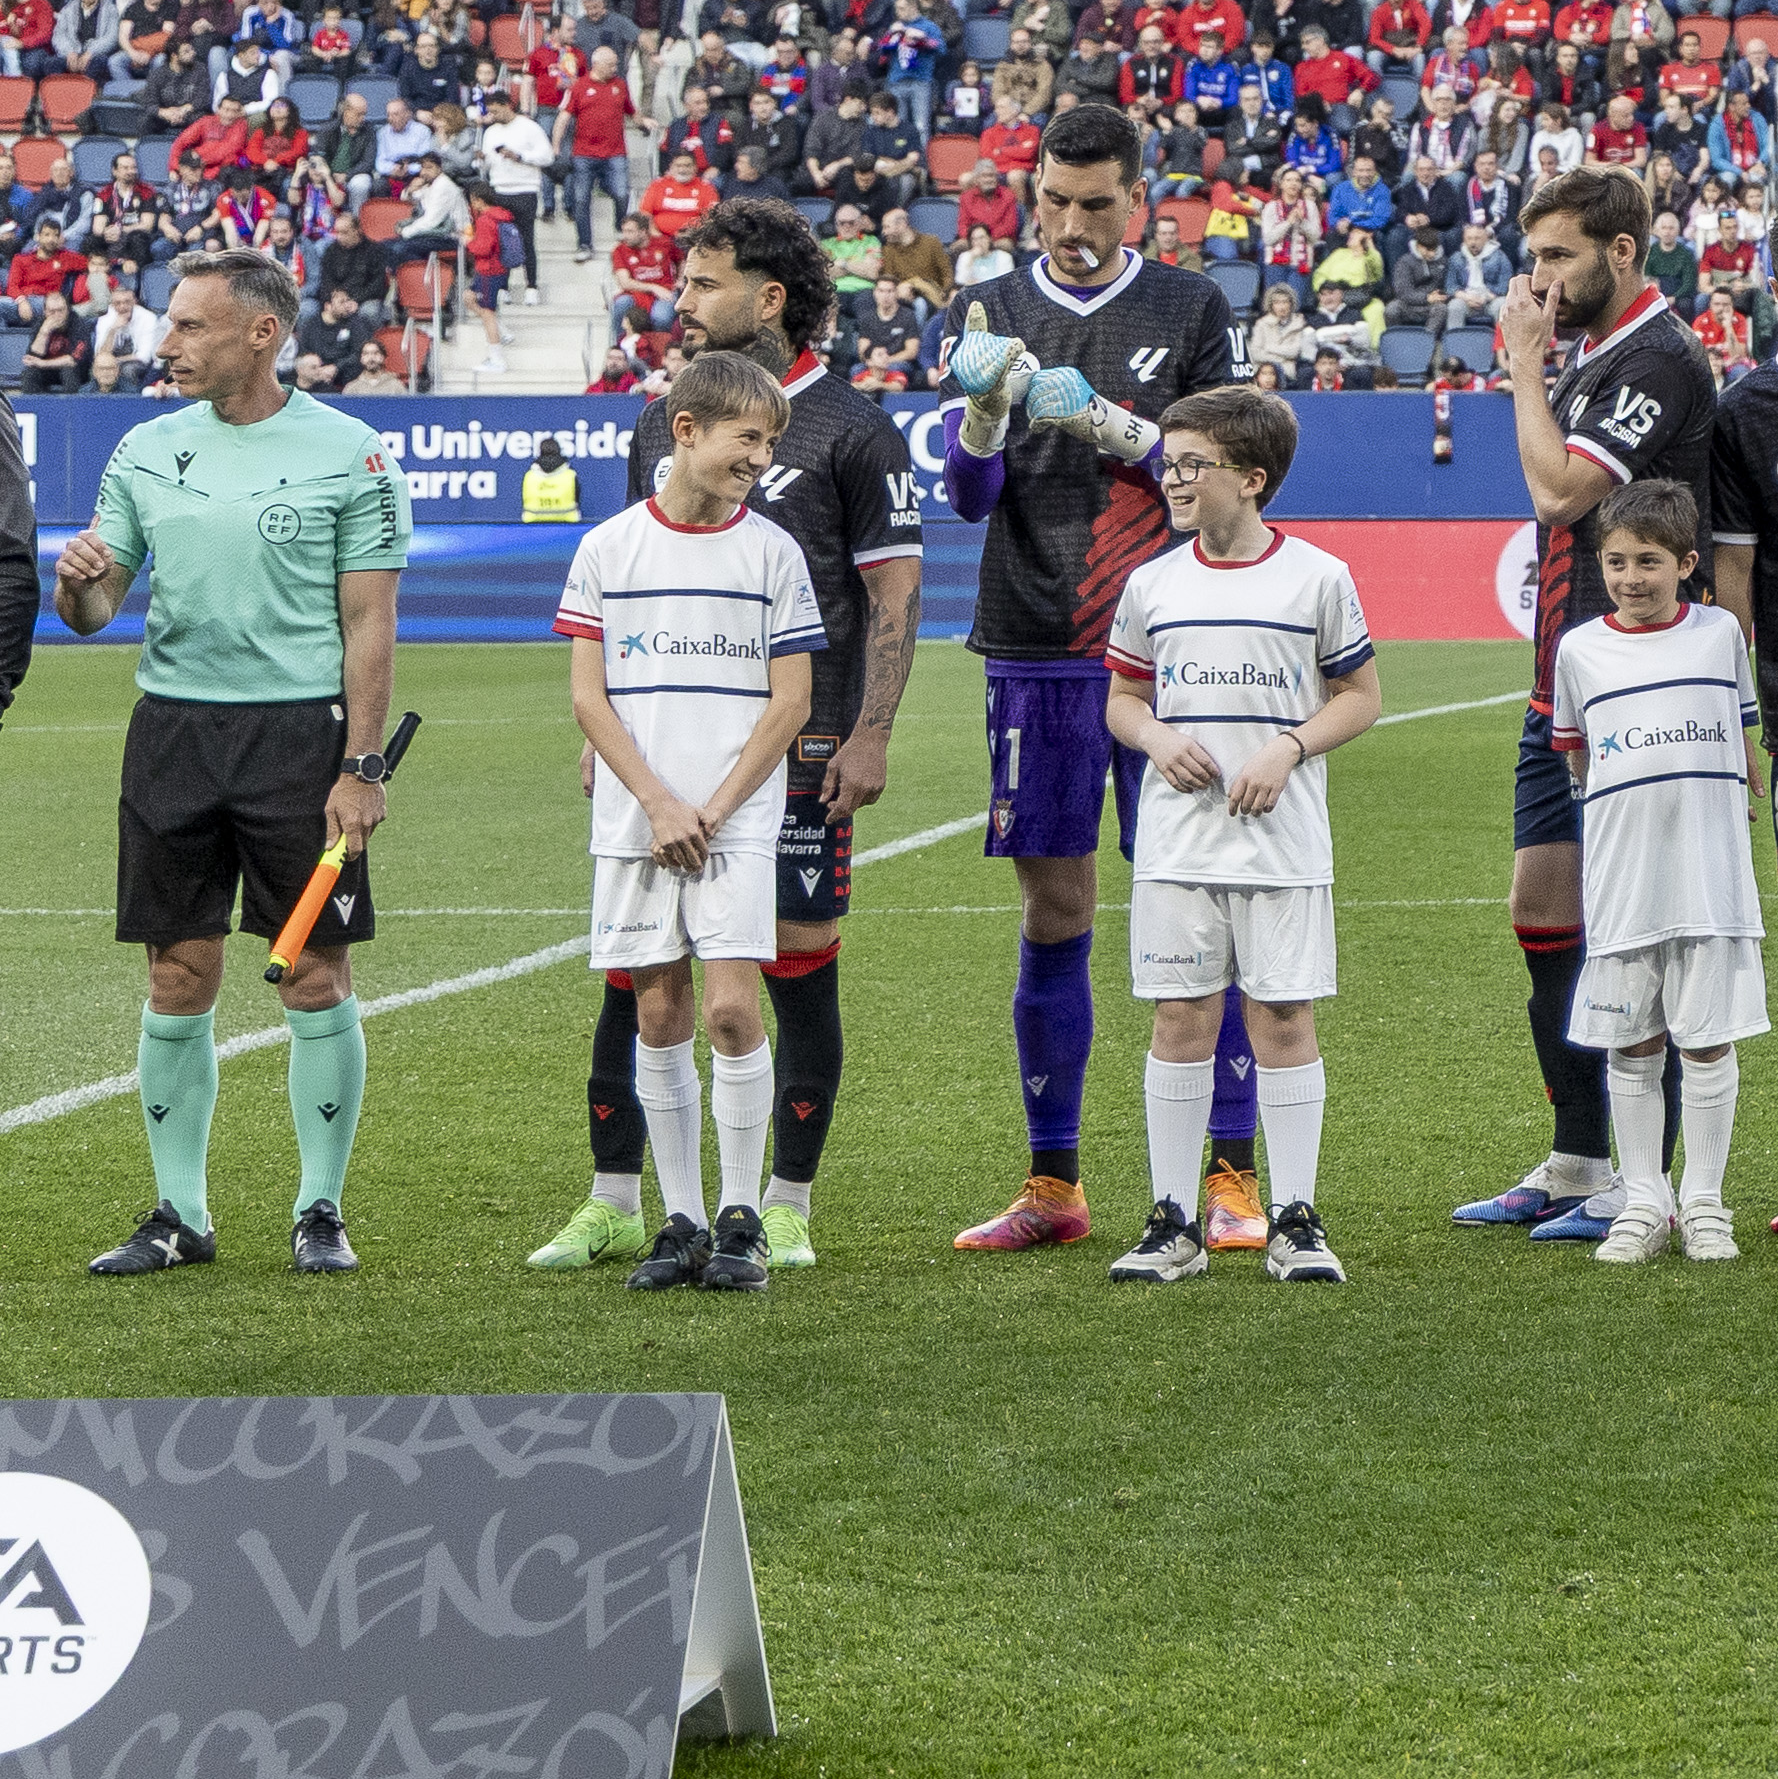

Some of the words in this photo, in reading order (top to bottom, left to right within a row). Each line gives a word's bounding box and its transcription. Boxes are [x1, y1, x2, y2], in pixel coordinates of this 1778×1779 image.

[1613, 385, 1662, 435] VS
[1124, 418, 1143, 445] SH
[1598, 416, 1642, 449] RACISM
[377, 474, 397, 551] WÜRTH
[653, 631, 762, 661] CaixaBank
[1181, 662, 1290, 689] CaixaBank
[1624, 720, 1728, 750] CaixaBank
[1005, 728, 1021, 790] 1
[781, 827, 825, 840] ersidad
[614, 922, 659, 933] CaixaBank
[1151, 953, 1196, 965] CaixaBank
[0, 1537, 86, 1626] A
